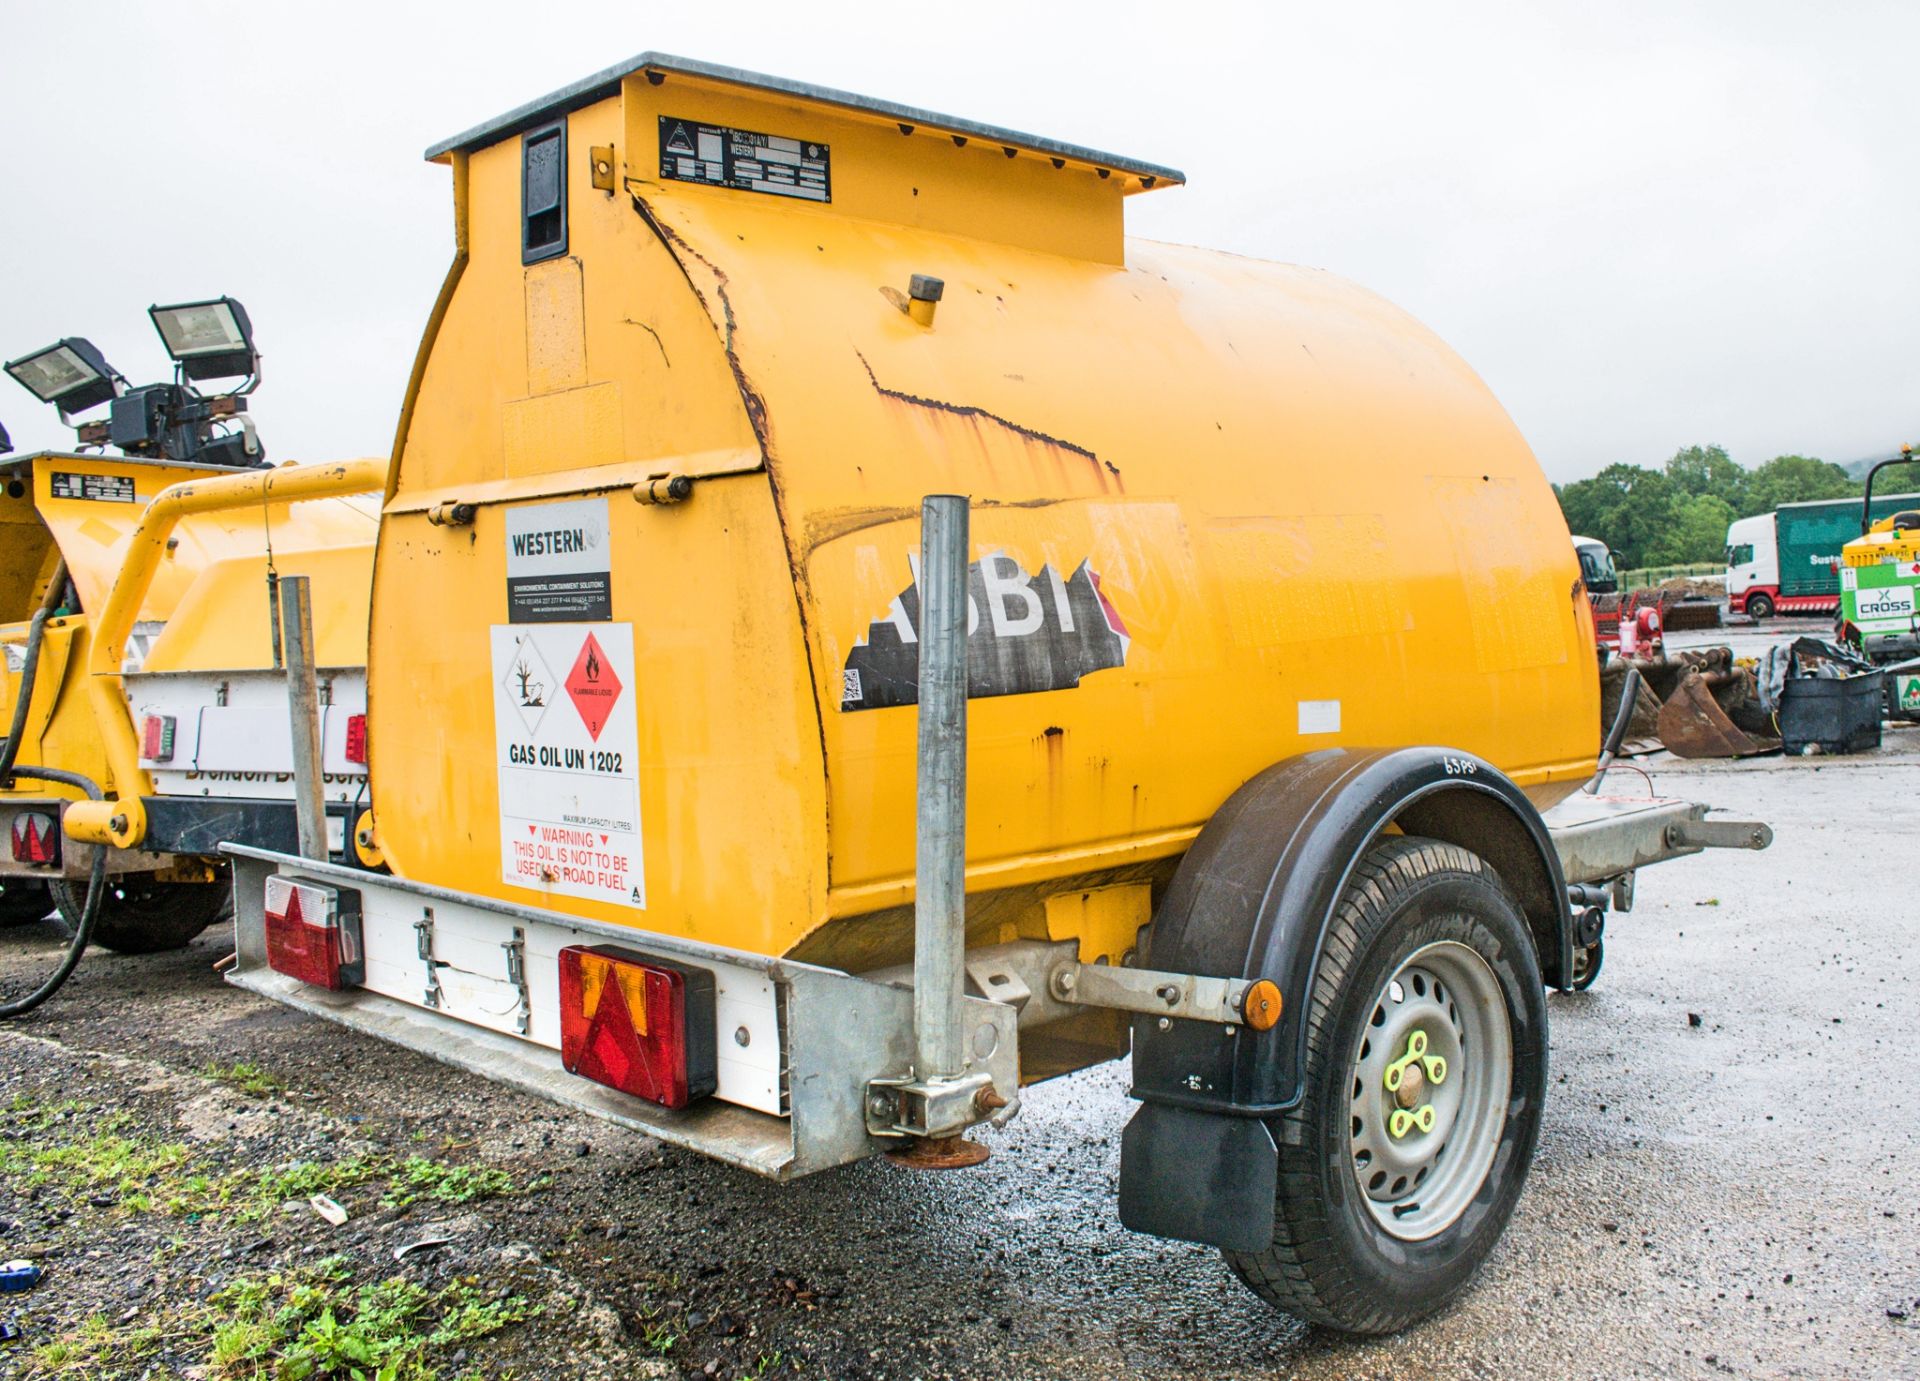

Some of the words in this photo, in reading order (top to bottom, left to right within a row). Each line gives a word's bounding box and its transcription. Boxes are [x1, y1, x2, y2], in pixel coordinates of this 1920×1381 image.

[512, 528, 584, 557] WESTERN
[580, 581, 605, 589] SOLUTIONS
[1860, 600, 1911, 614] CROSS
[574, 688, 598, 696] FLAMMABLE
[592, 722, 597, 732] 3
[510, 744, 536, 764] GAS
[540, 745, 562, 768] OIL
[565, 748, 584, 770] UN
[589, 751, 622, 774] 1202
[563, 815, 586, 825] MAXIMUM
[588, 818, 611, 828] CAPACITY
[612, 820, 632, 831] (LITRES)
[542, 827, 594, 848] WARNING
[514, 841, 534, 857] THIS
[537, 844, 554, 860] OIL
[557, 846, 568, 862] IS
[570, 848, 593, 866] NOT
[595, 852, 611, 868] TO
[614, 856, 628, 873] BE
[516, 860, 543, 878] USED
[563, 867, 594, 885] ROAD
[598, 872, 627, 892] FUEL
